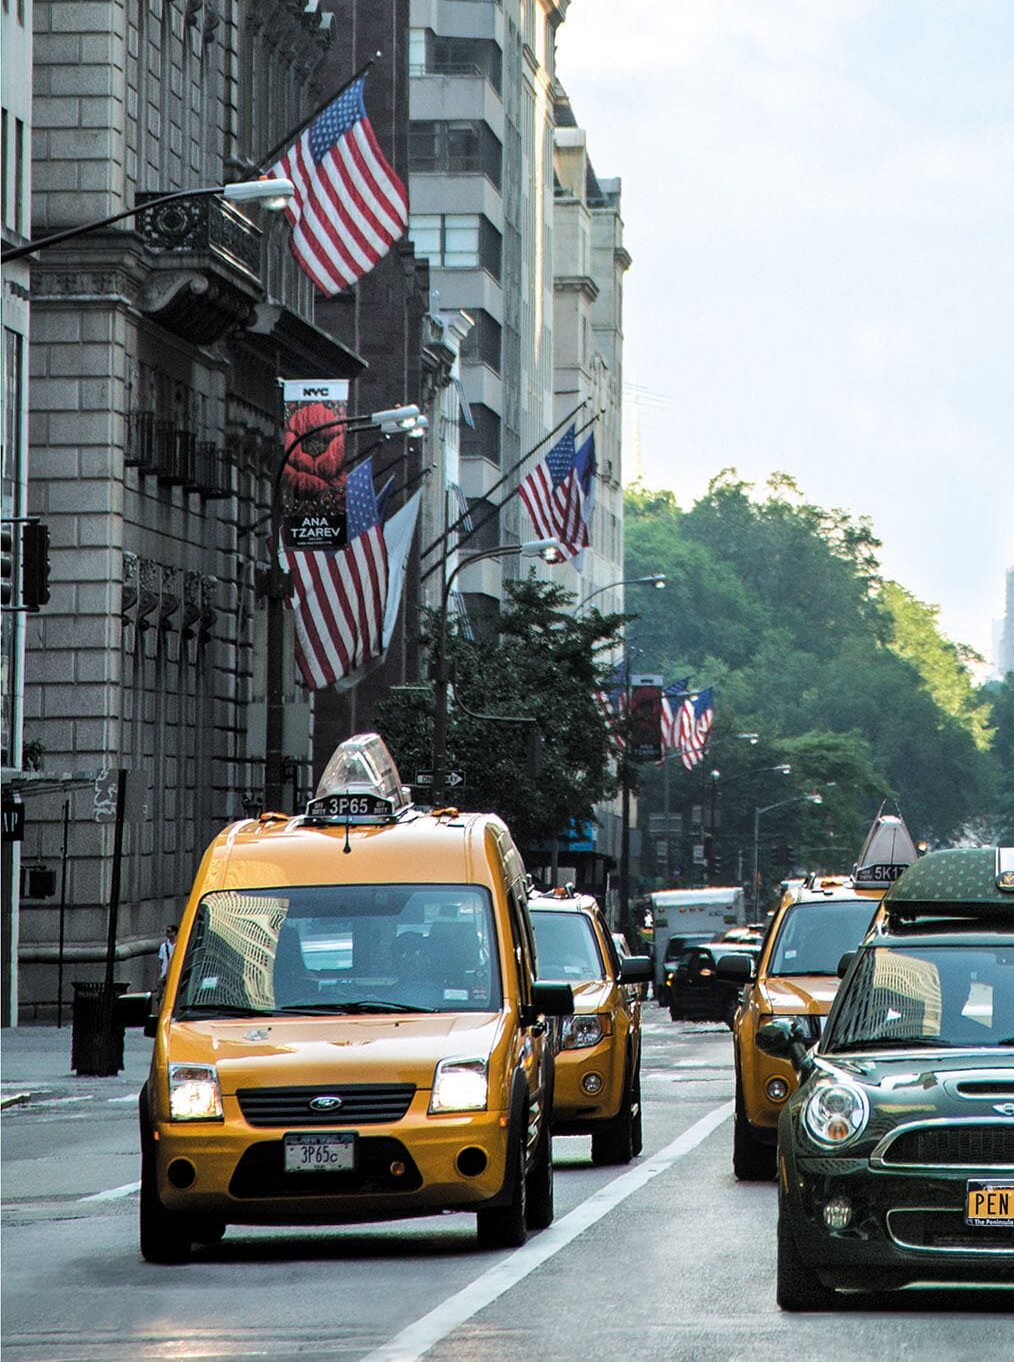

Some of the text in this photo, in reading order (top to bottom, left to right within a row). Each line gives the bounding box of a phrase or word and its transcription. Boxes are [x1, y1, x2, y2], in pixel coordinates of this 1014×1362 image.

[303, 388, 329, 396] NYC
[301, 517, 329, 526] ANA
[290, 528, 340, 538] TZAREV
[329, 798, 368, 814] 3P65
[975, 1193, 1009, 1215] PEN
